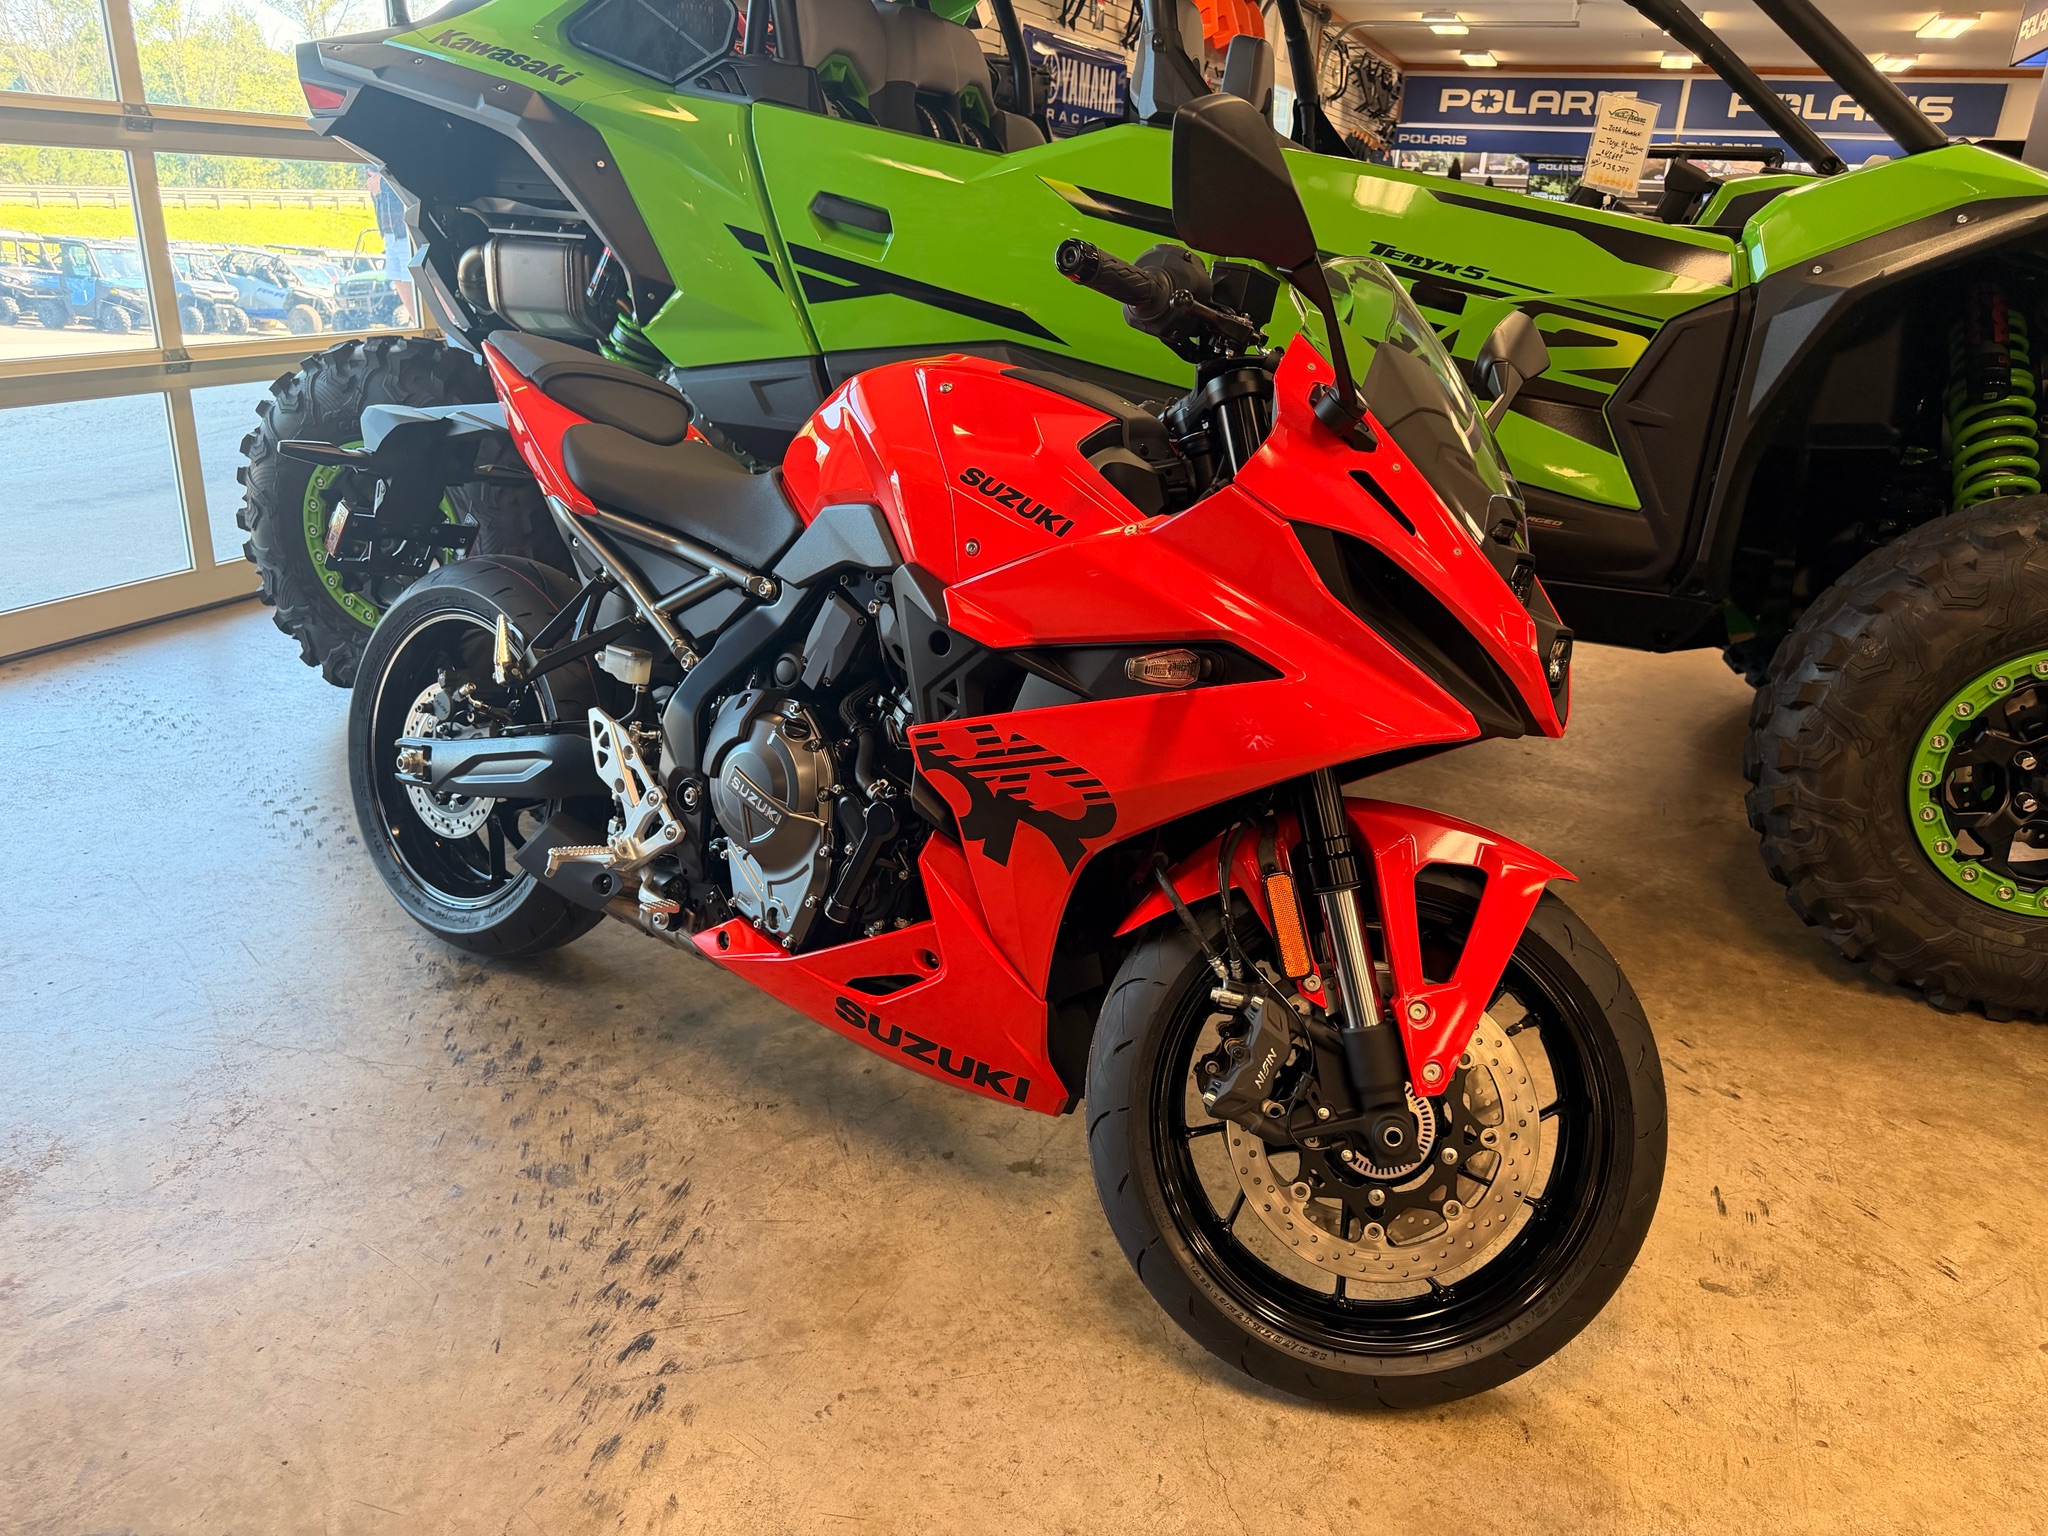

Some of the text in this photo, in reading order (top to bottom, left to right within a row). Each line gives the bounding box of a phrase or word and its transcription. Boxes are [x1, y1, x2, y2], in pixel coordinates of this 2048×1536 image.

[428, 29, 585, 86] Kawasaki
[1061, 56, 1117, 115] YAMAHA
[1398, 133, 1468, 146] POLARIS
[960, 467, 1075, 538] SUZUKI
[731, 776, 783, 825] SUZUKI
[834, 996, 1031, 1103] SUZUKI
